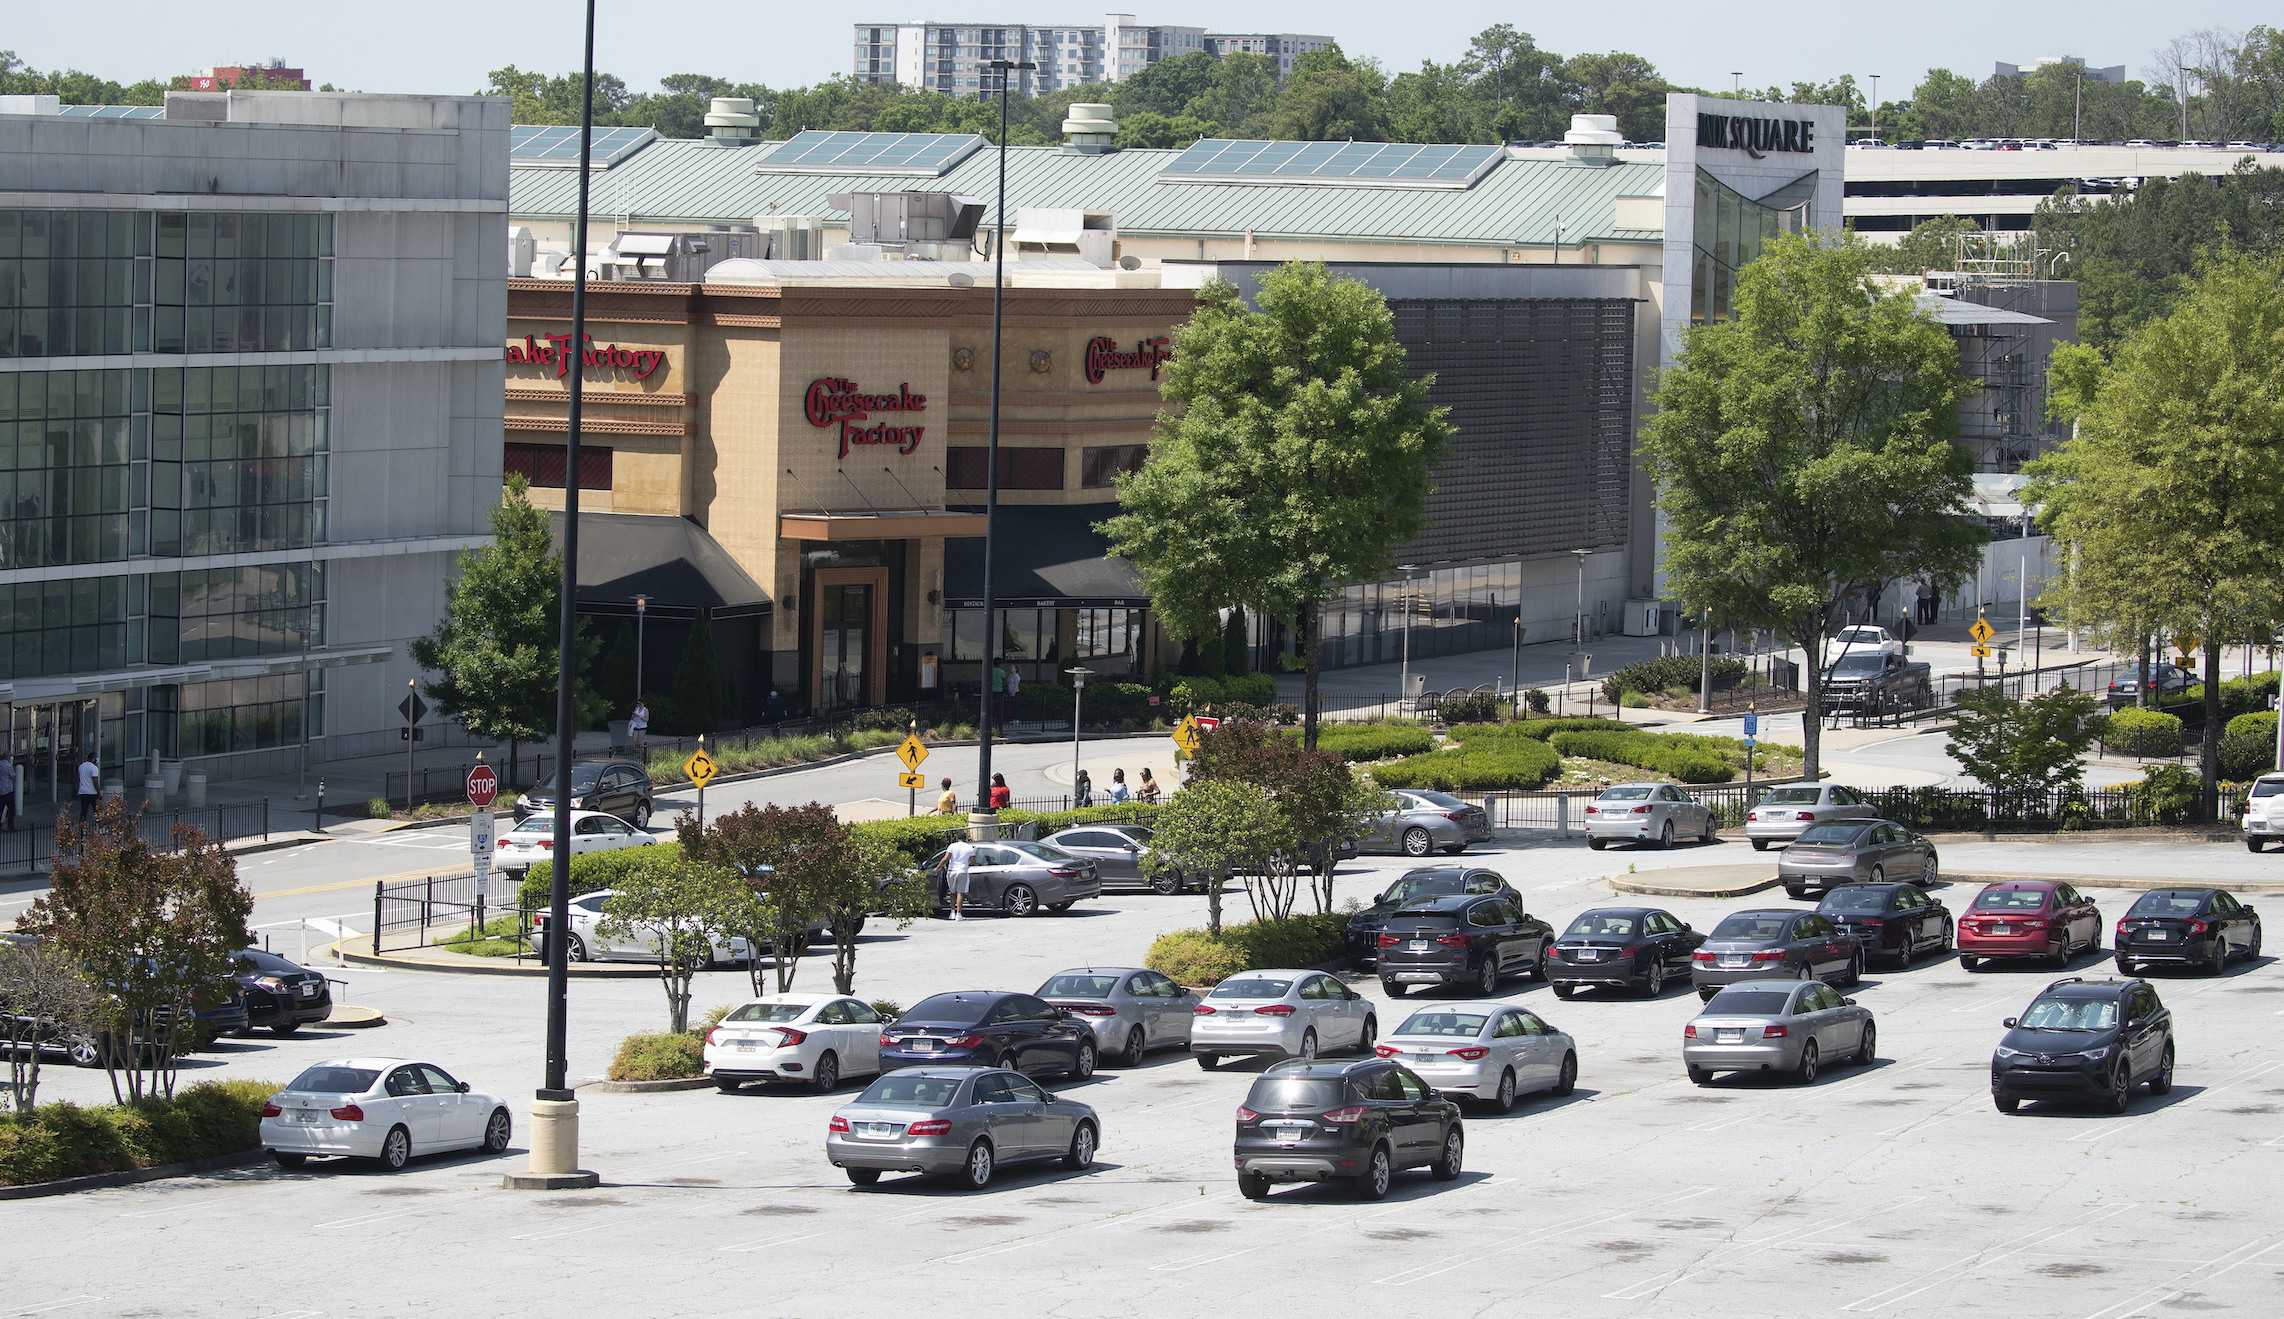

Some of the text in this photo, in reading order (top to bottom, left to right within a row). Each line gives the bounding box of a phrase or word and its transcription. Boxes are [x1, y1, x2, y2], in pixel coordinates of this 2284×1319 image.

[1730, 116, 1814, 159] SQUARE
[506, 333, 557, 364] ake
[1085, 336, 1155, 384] Cheesecake
[804, 377, 927, 428] Cheesecake
[834, 378, 859, 394] The
[831, 412, 926, 460] Factory
[470, 778, 495, 794] STOP
